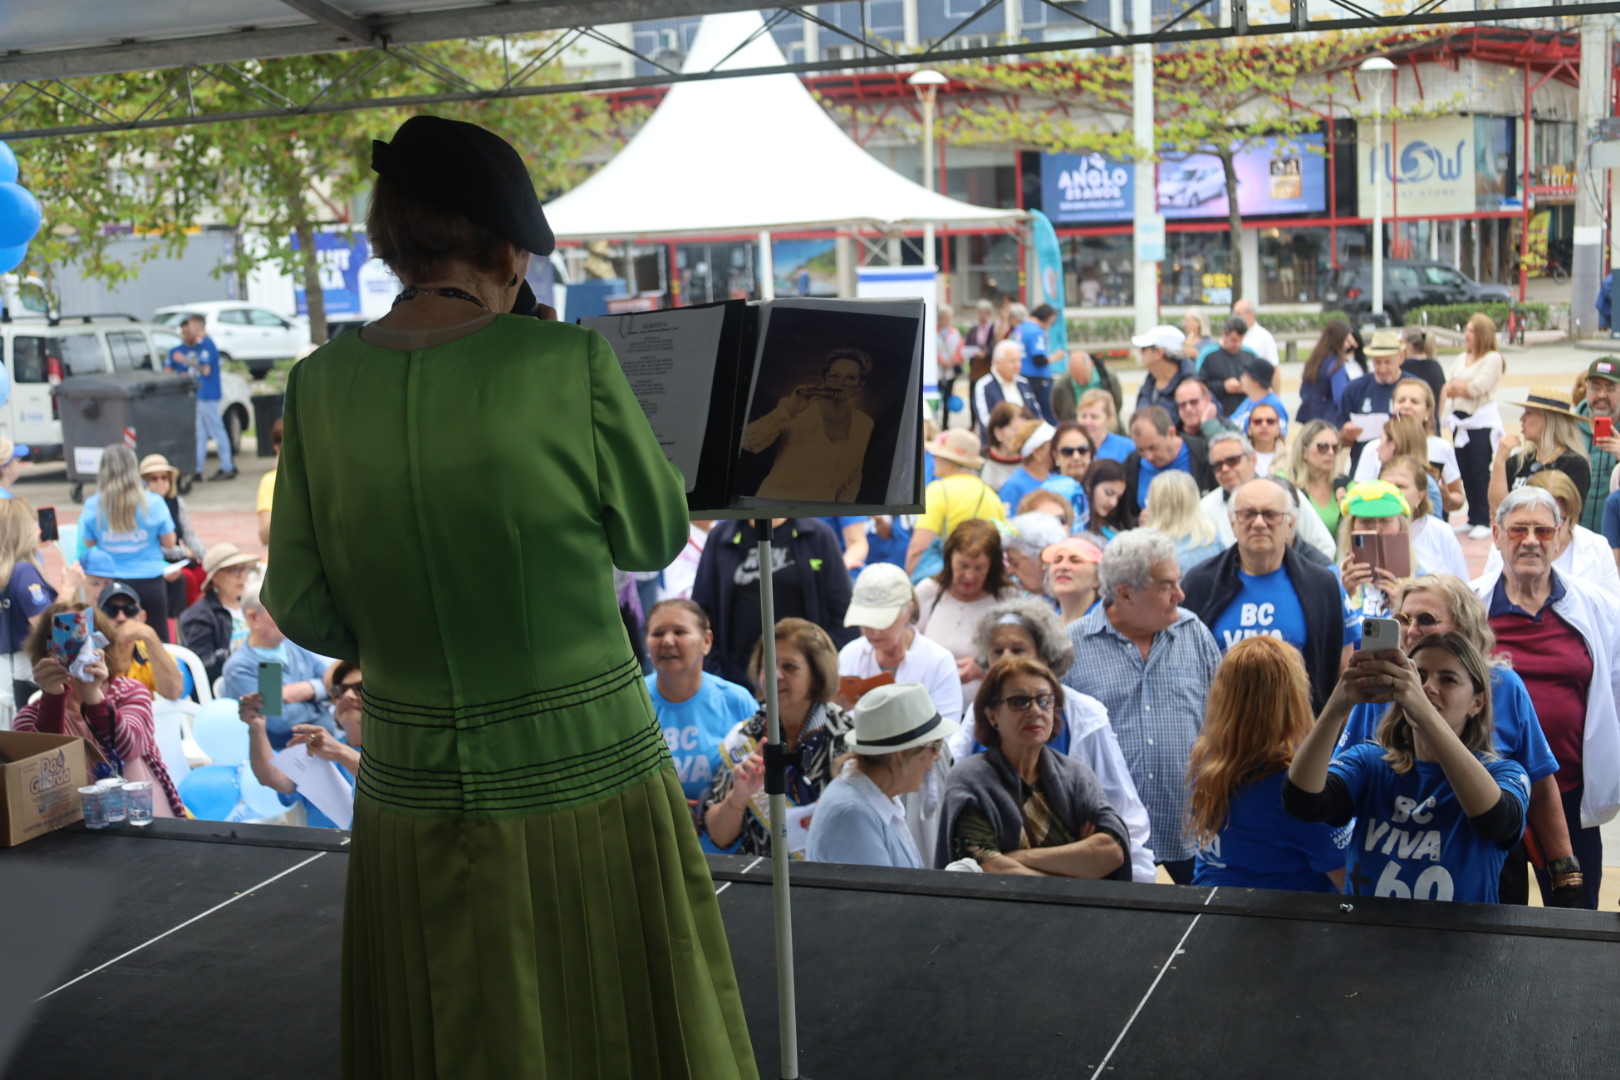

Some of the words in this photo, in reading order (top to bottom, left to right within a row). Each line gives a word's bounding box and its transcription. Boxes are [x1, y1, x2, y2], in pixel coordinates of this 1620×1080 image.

[744, 547, 789, 569] RN
[1240, 602, 1275, 627] BC
[664, 725, 699, 752] BC
[674, 754, 713, 783] VA
[1391, 795, 1437, 824] BC
[1364, 818, 1441, 862] VIVA
[1374, 860, 1455, 902] 60
